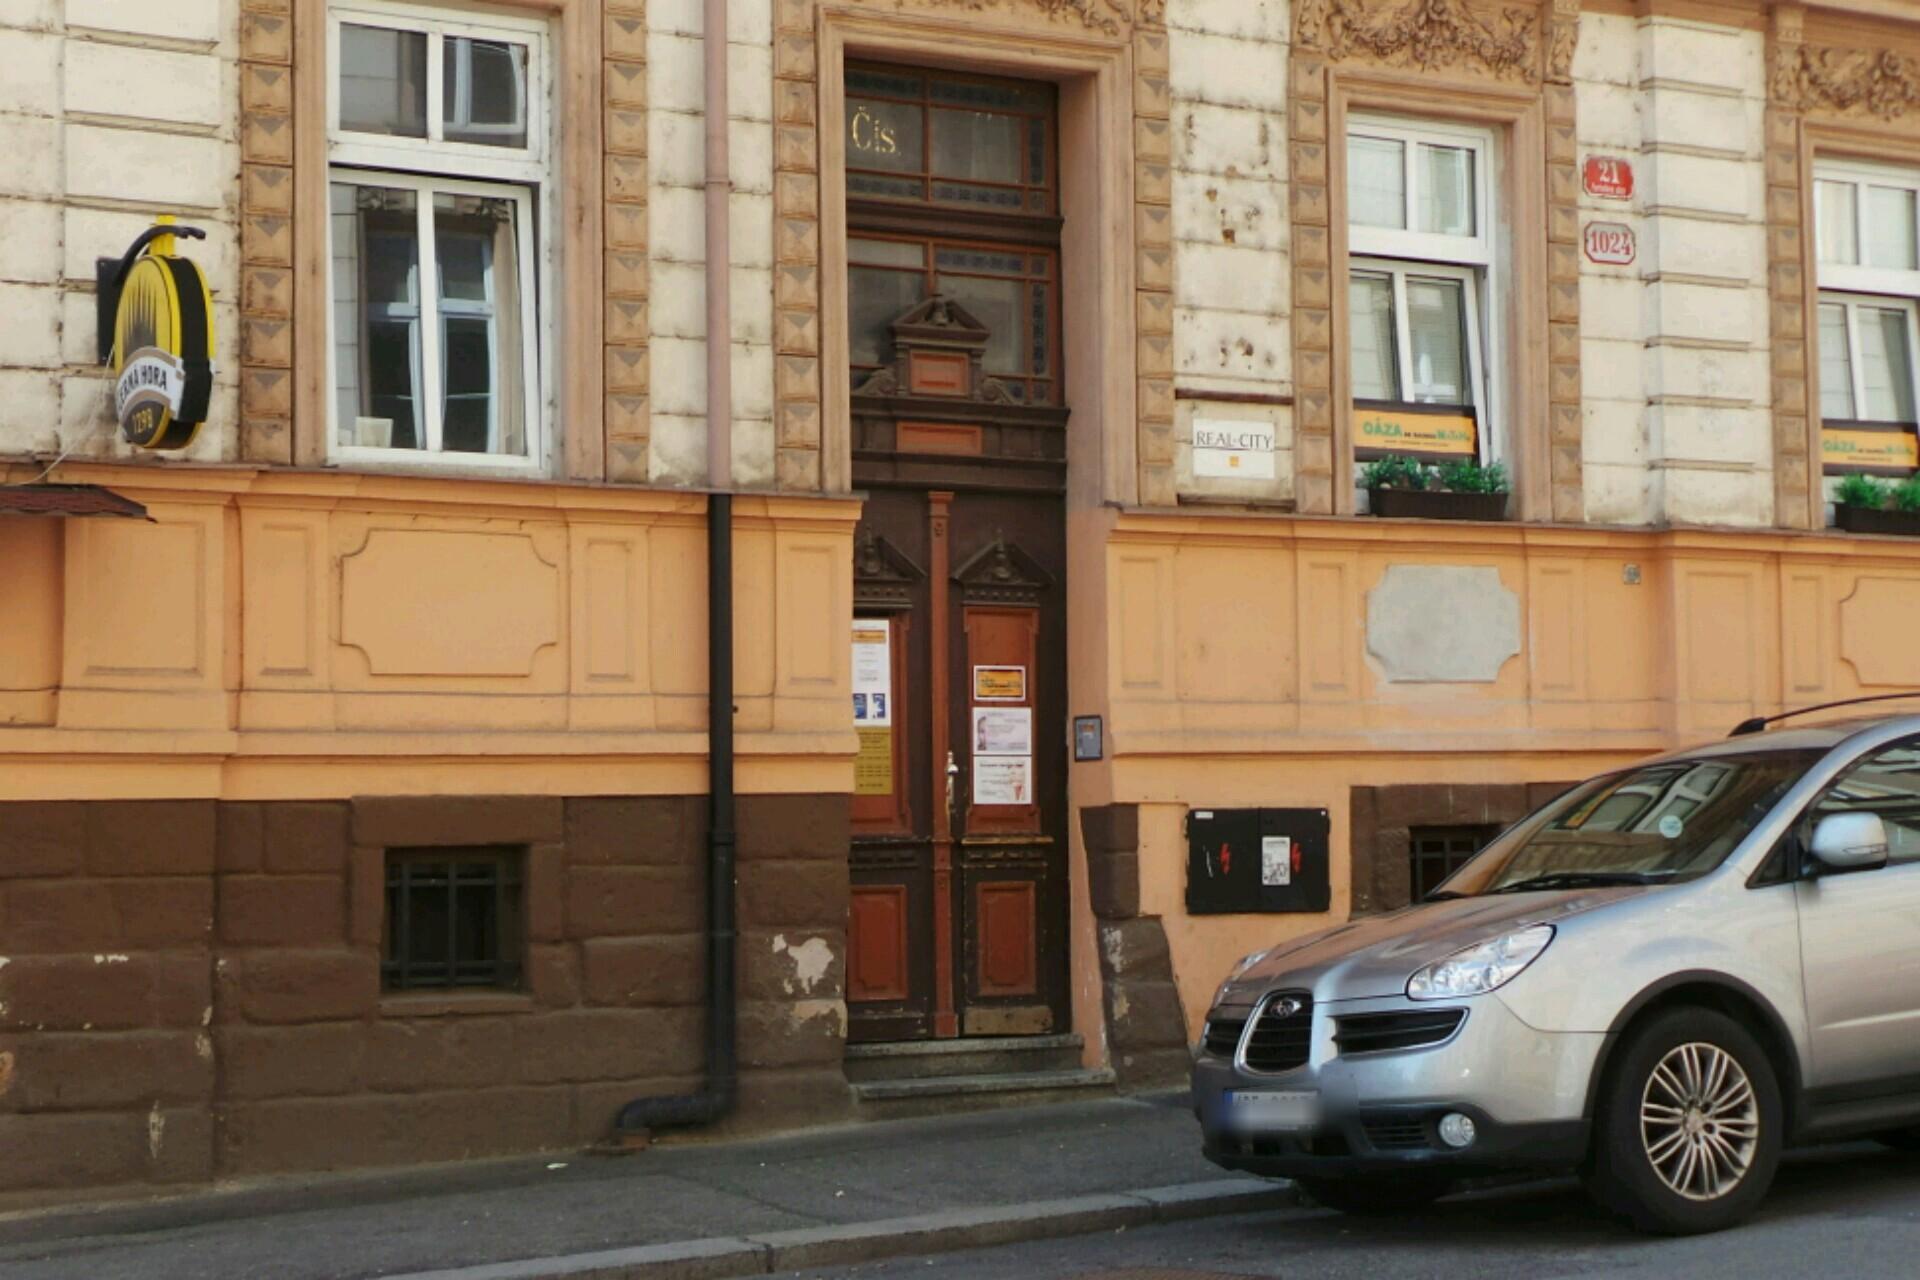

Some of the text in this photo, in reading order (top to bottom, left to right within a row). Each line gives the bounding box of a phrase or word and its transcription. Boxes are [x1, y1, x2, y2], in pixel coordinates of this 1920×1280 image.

[1598, 160, 1620, 184] 21
[1591, 230, 1631, 256] 1024
[141, 364, 167, 391] HORA
